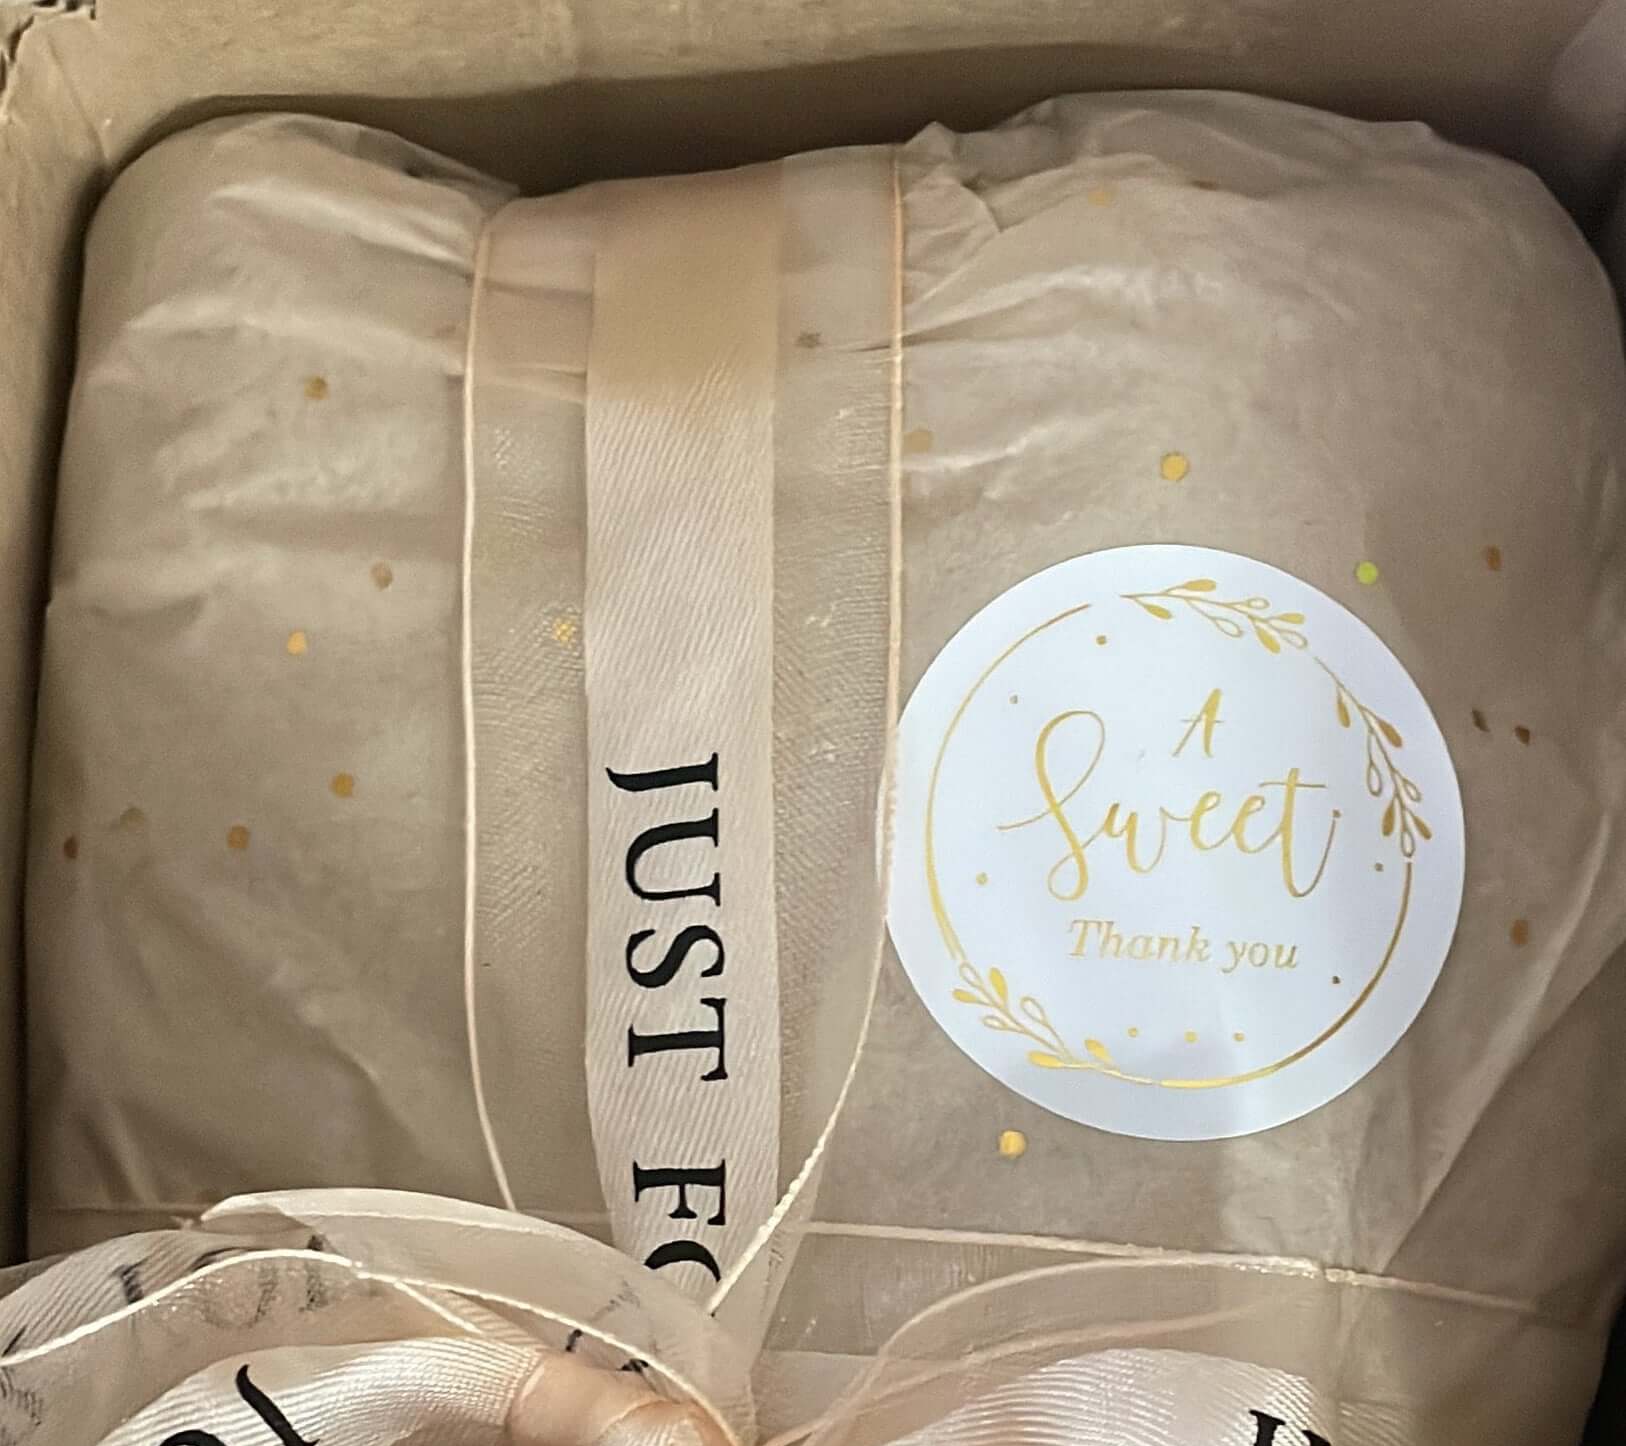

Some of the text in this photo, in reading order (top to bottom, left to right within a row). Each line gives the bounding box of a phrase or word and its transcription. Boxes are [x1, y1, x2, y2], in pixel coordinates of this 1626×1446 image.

[1171, 687, 1225, 758] A
[997, 709, 1341, 901] Sweet
[605, 751, 728, 1082] JUST
[1067, 918, 1300, 974] Thank you
